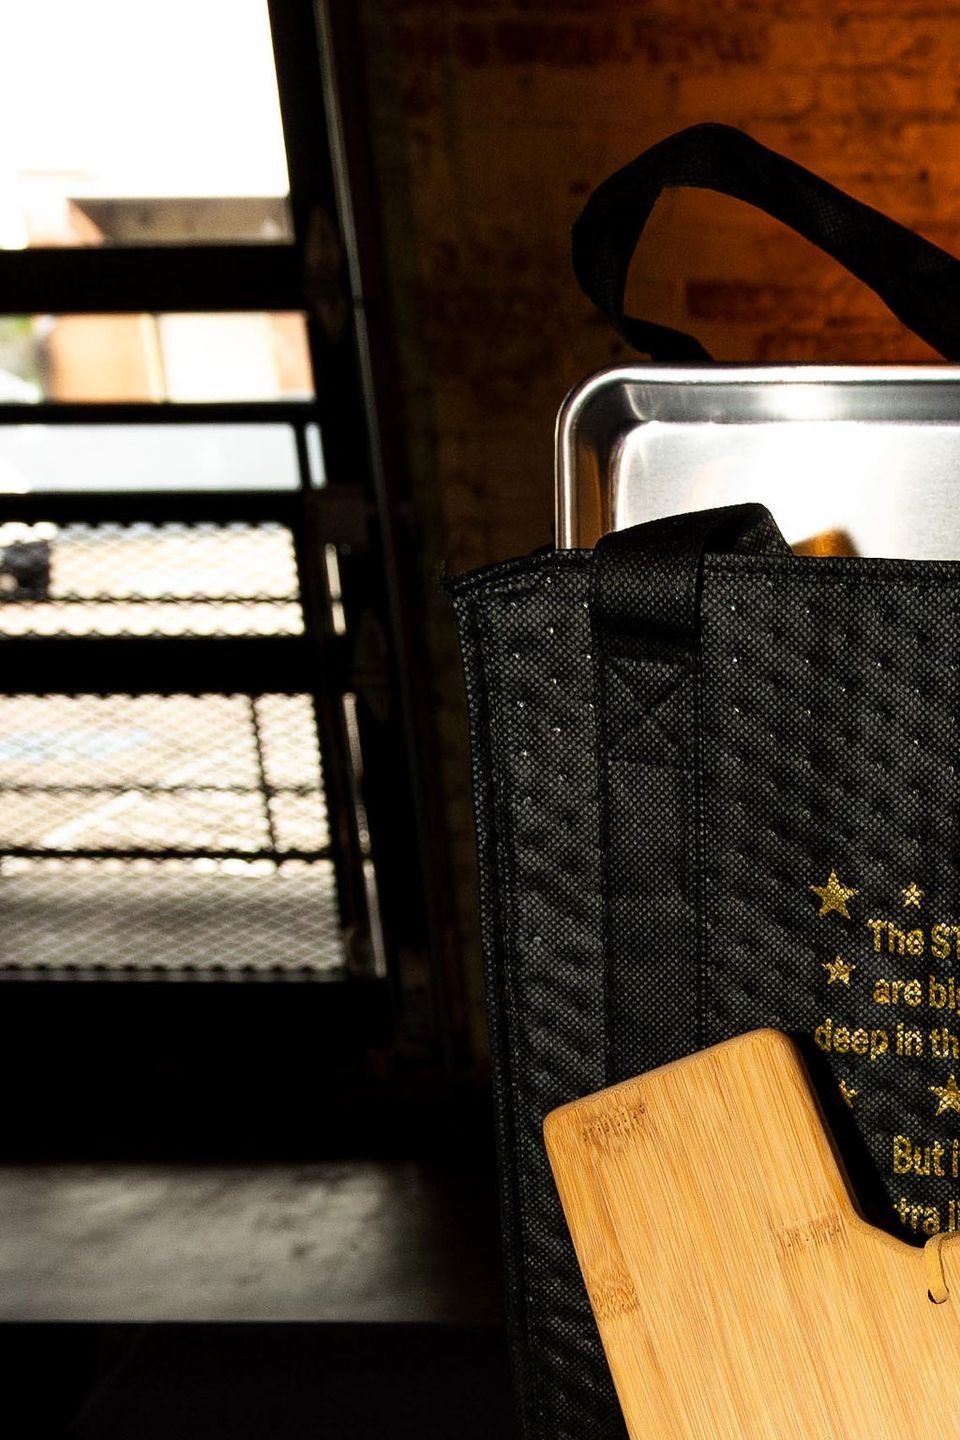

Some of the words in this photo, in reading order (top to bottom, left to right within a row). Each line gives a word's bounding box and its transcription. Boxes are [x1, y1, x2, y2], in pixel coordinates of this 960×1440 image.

[866, 918, 925, 956] The
[872, 978, 923, 1008] are
[815, 1018, 889, 1062] deep
[895, 1022, 924, 1057] in
[893, 1135, 945, 1177] But
